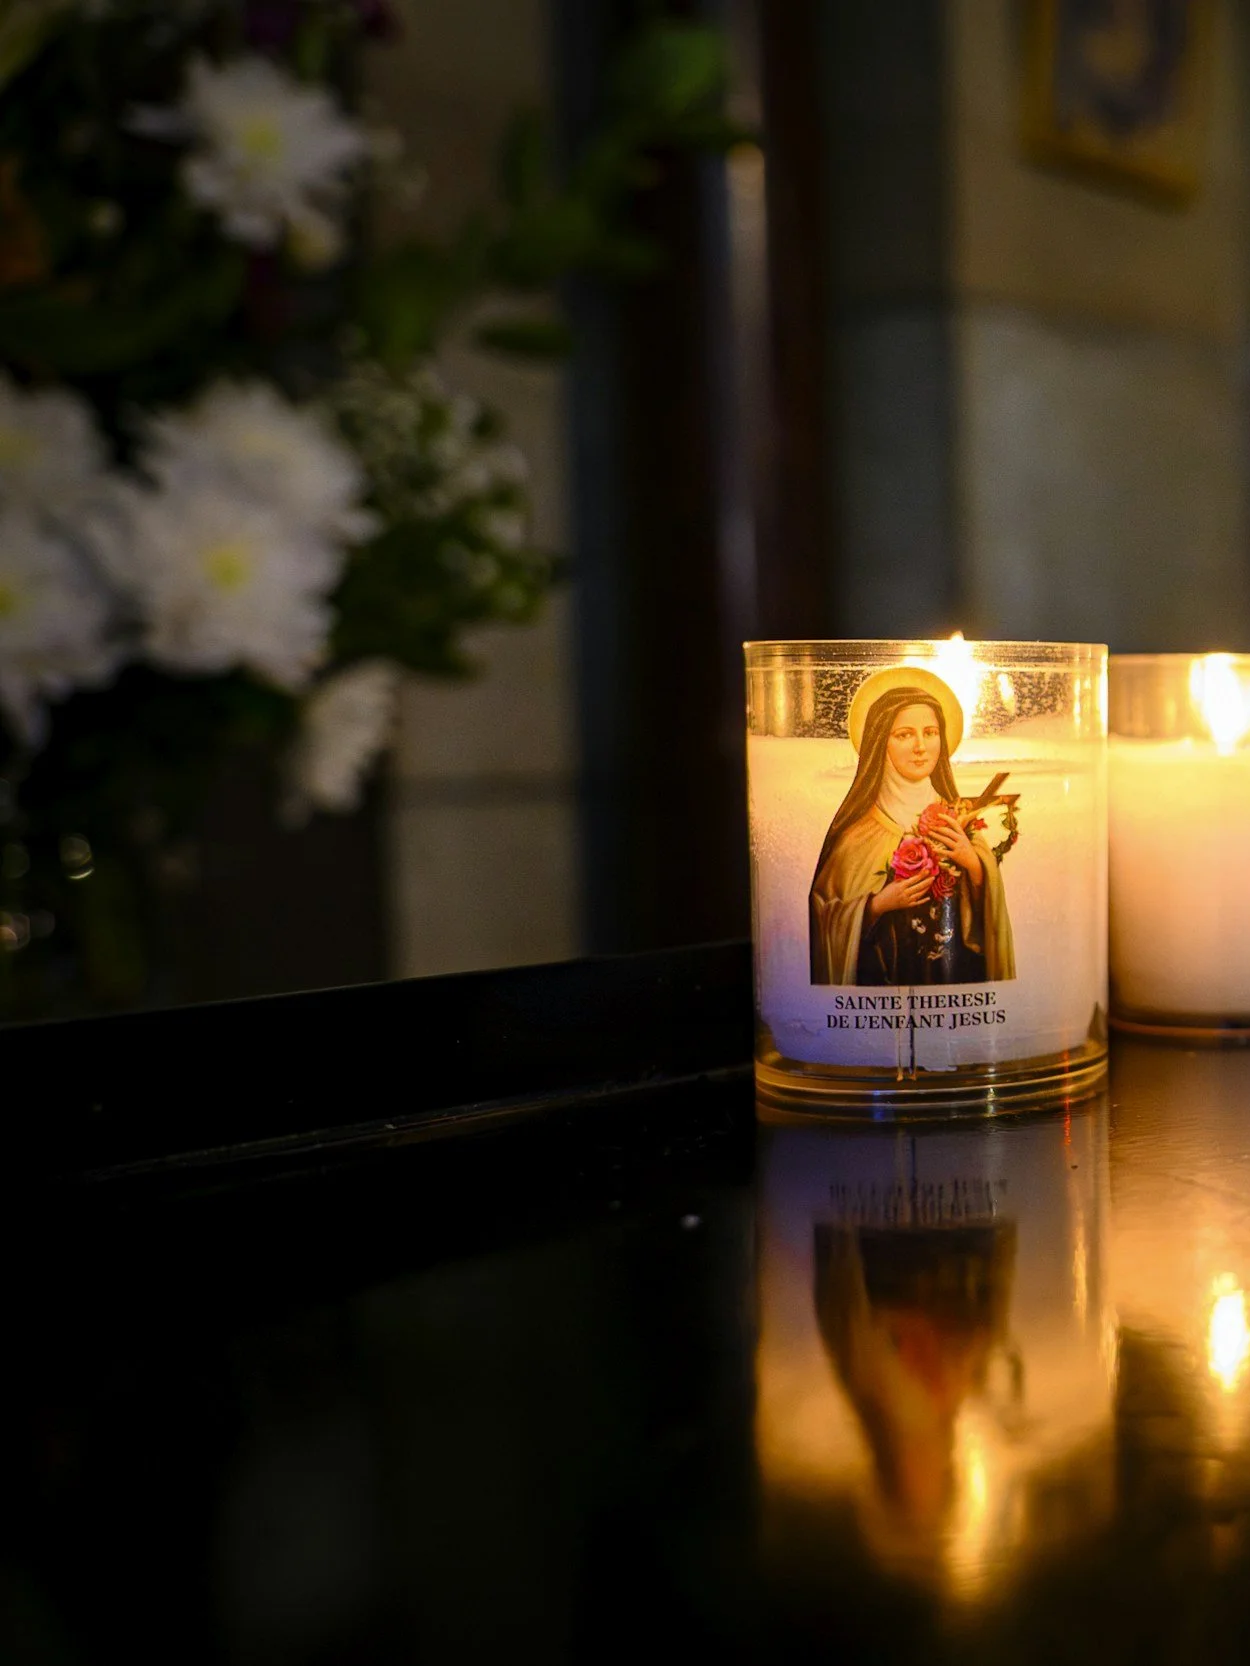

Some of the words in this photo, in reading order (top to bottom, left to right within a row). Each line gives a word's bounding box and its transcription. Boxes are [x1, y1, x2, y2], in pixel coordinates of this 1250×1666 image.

[835, 995, 902, 1010] SAINTE
[906, 991, 997, 1010] THERESE
[827, 1014, 850, 1029] DE
[854, 1013, 945, 1030] L'ENFANT
[948, 1009, 1006, 1030] JESUS
